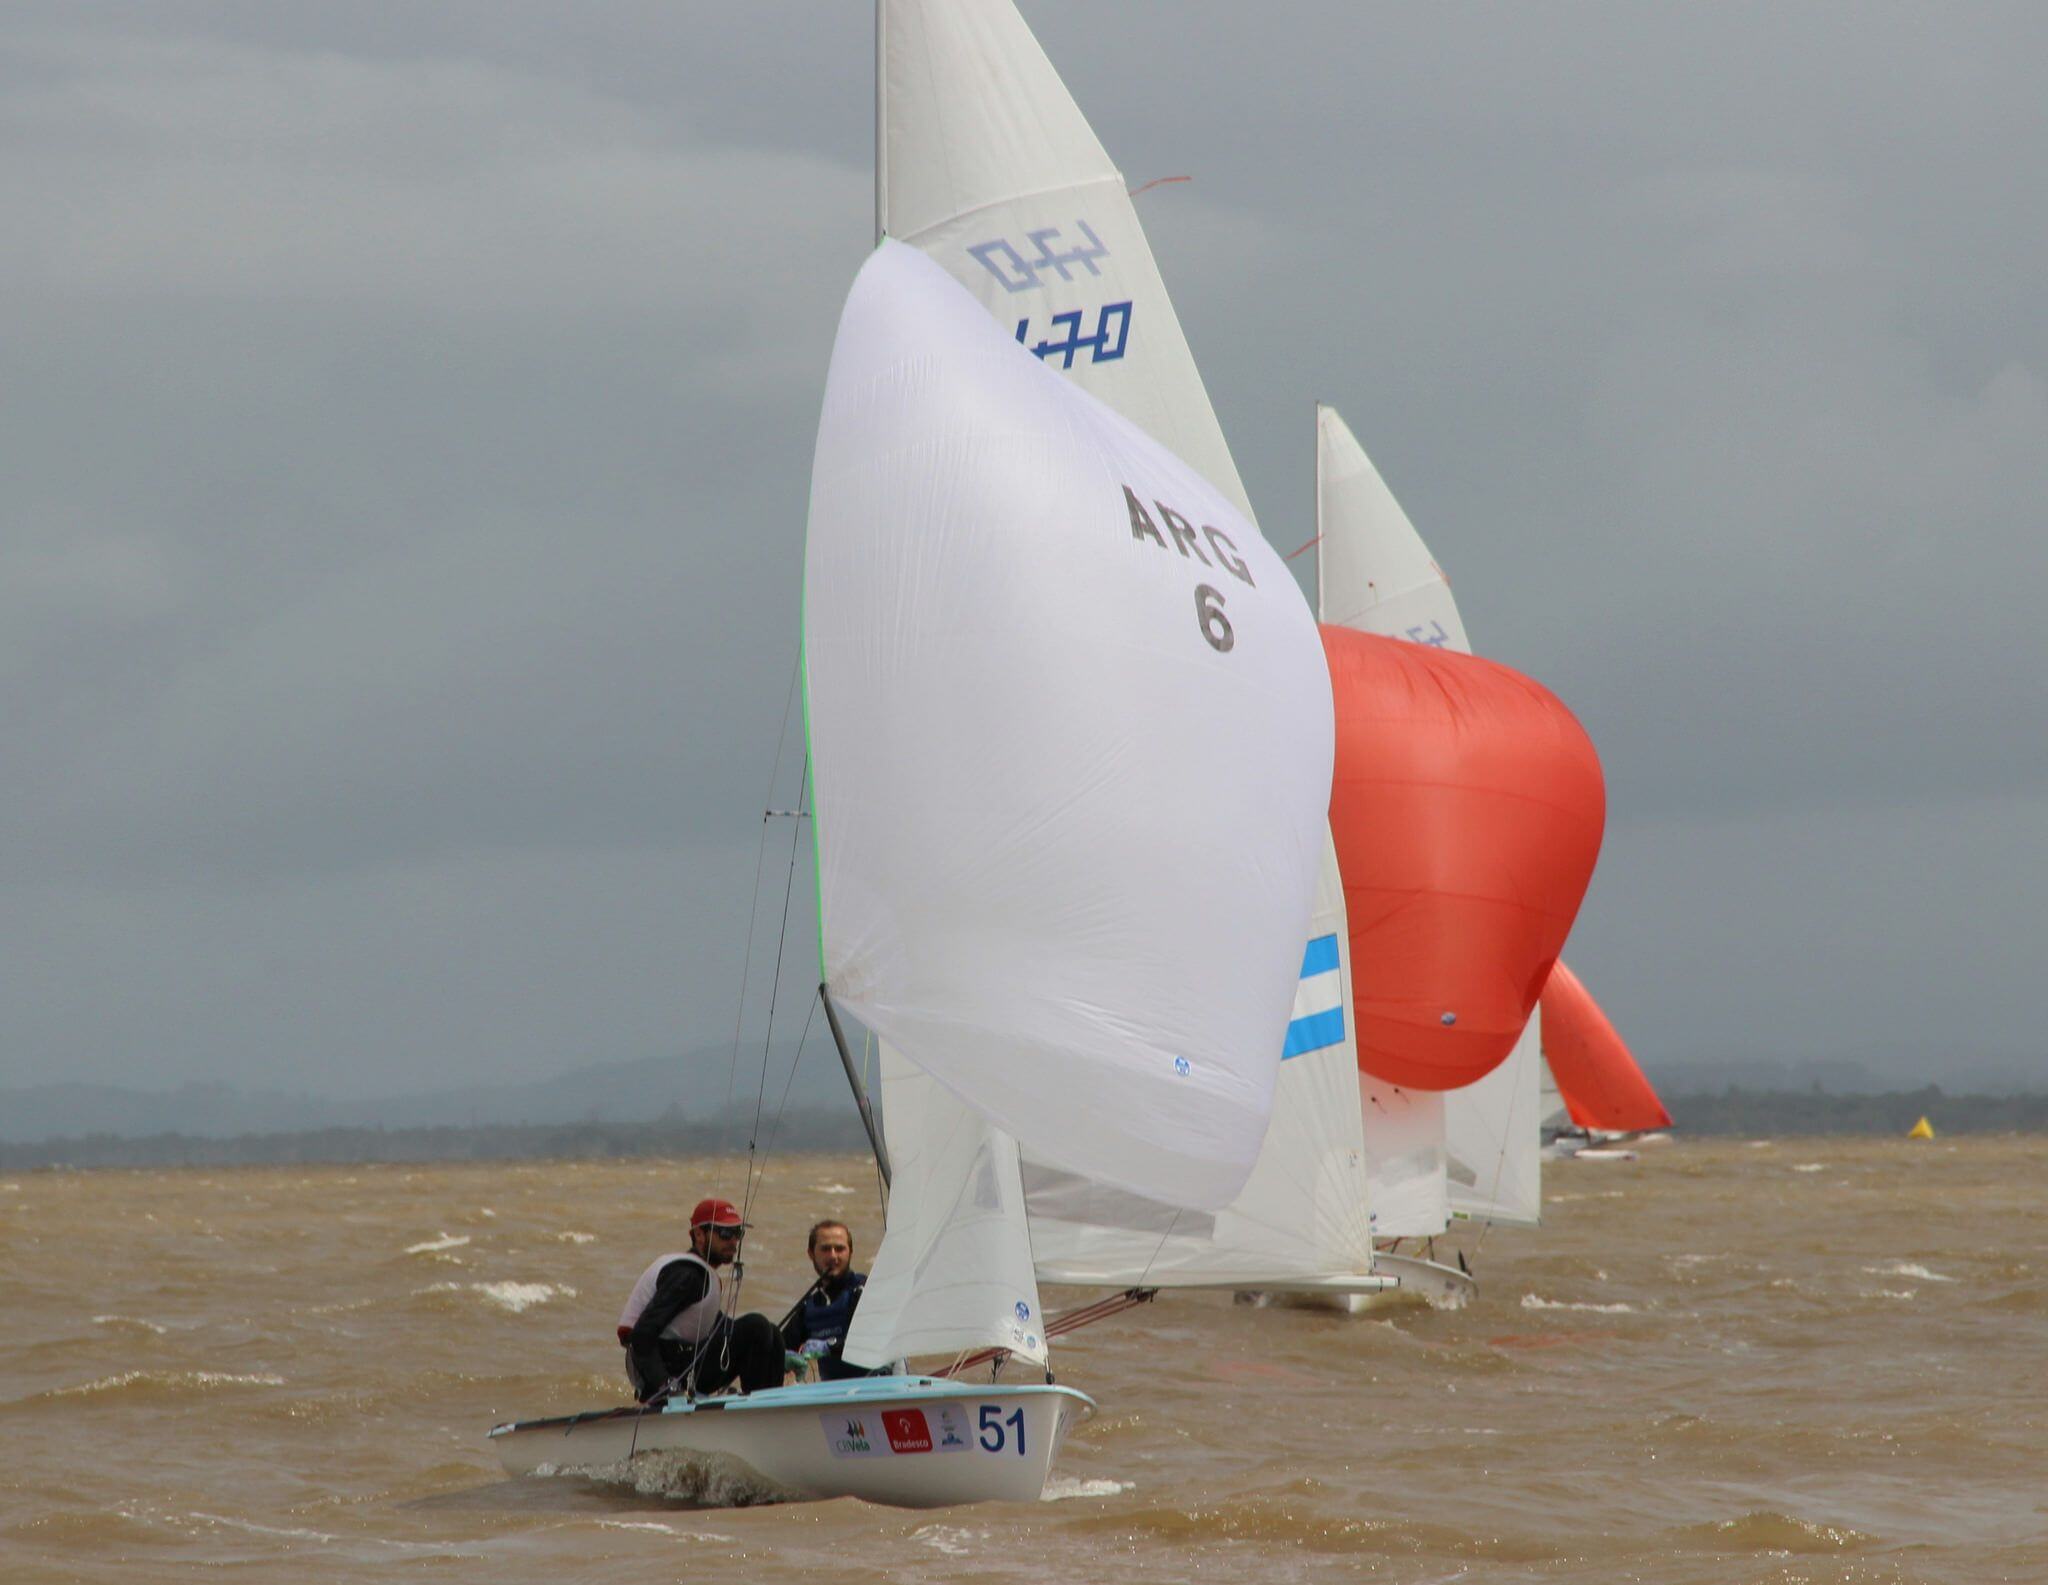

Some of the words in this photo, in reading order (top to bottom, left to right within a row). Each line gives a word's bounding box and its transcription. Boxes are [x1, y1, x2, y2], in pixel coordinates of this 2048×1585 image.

[1121, 484, 1255, 588] ARG
[1194, 583, 1235, 653] 6
[893, 1438, 930, 1450] Bradesco
[979, 1404, 1026, 1456] 51
